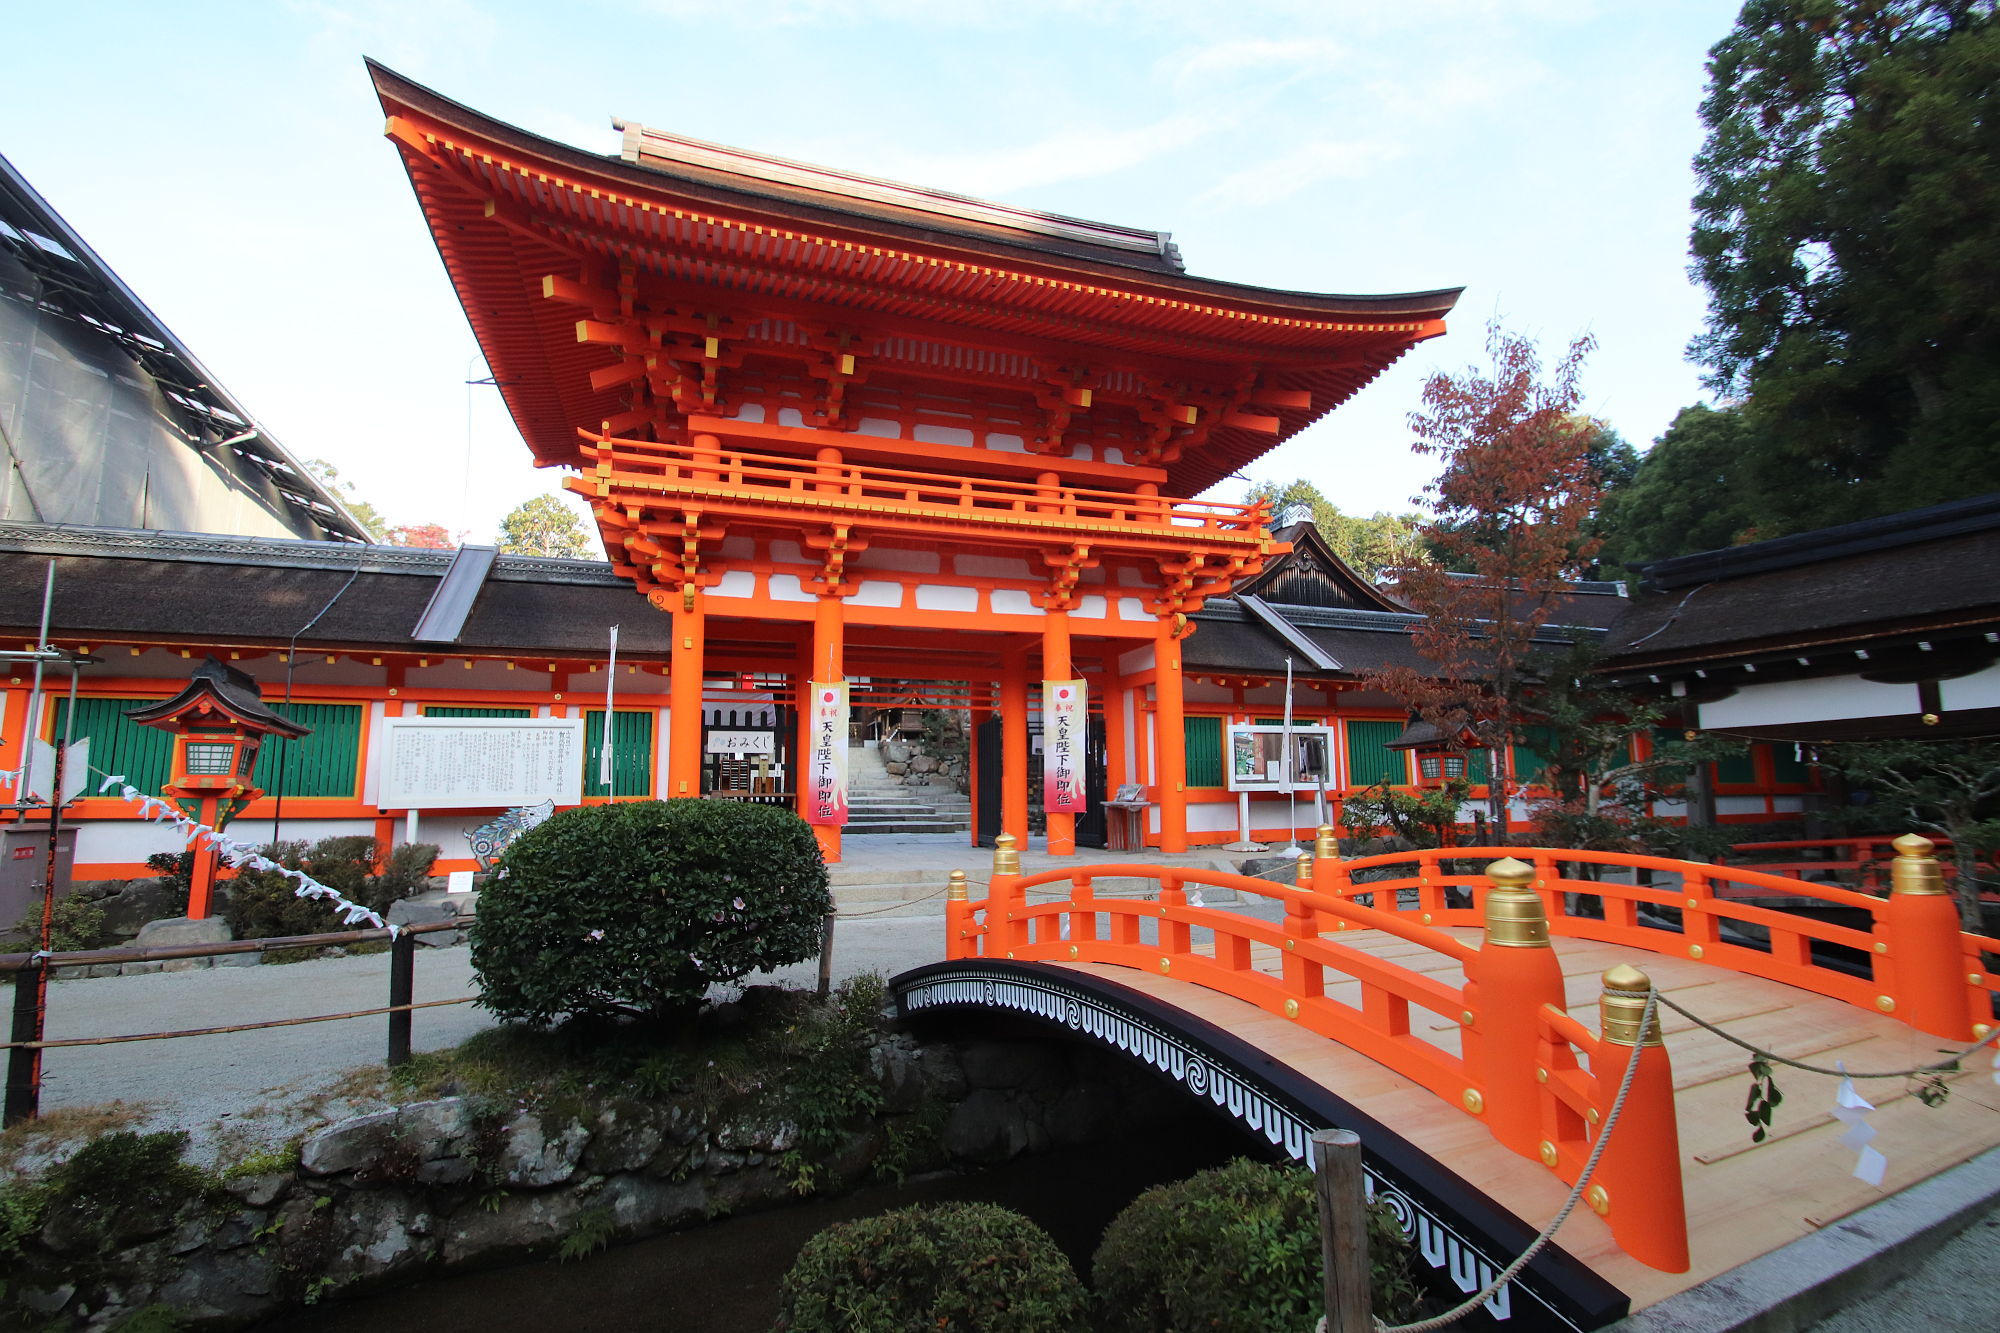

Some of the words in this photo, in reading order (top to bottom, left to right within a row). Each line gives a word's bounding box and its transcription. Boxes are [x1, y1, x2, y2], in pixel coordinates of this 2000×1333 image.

[820, 707, 839, 718] 奉祝
[1055, 704, 1074, 712] 奉祝
[727, 735, 771, 749] おみくじ
[1056, 715, 1072, 805] 天皇陛下御即位
[817, 721, 833, 818] 天皇陛下御即位
